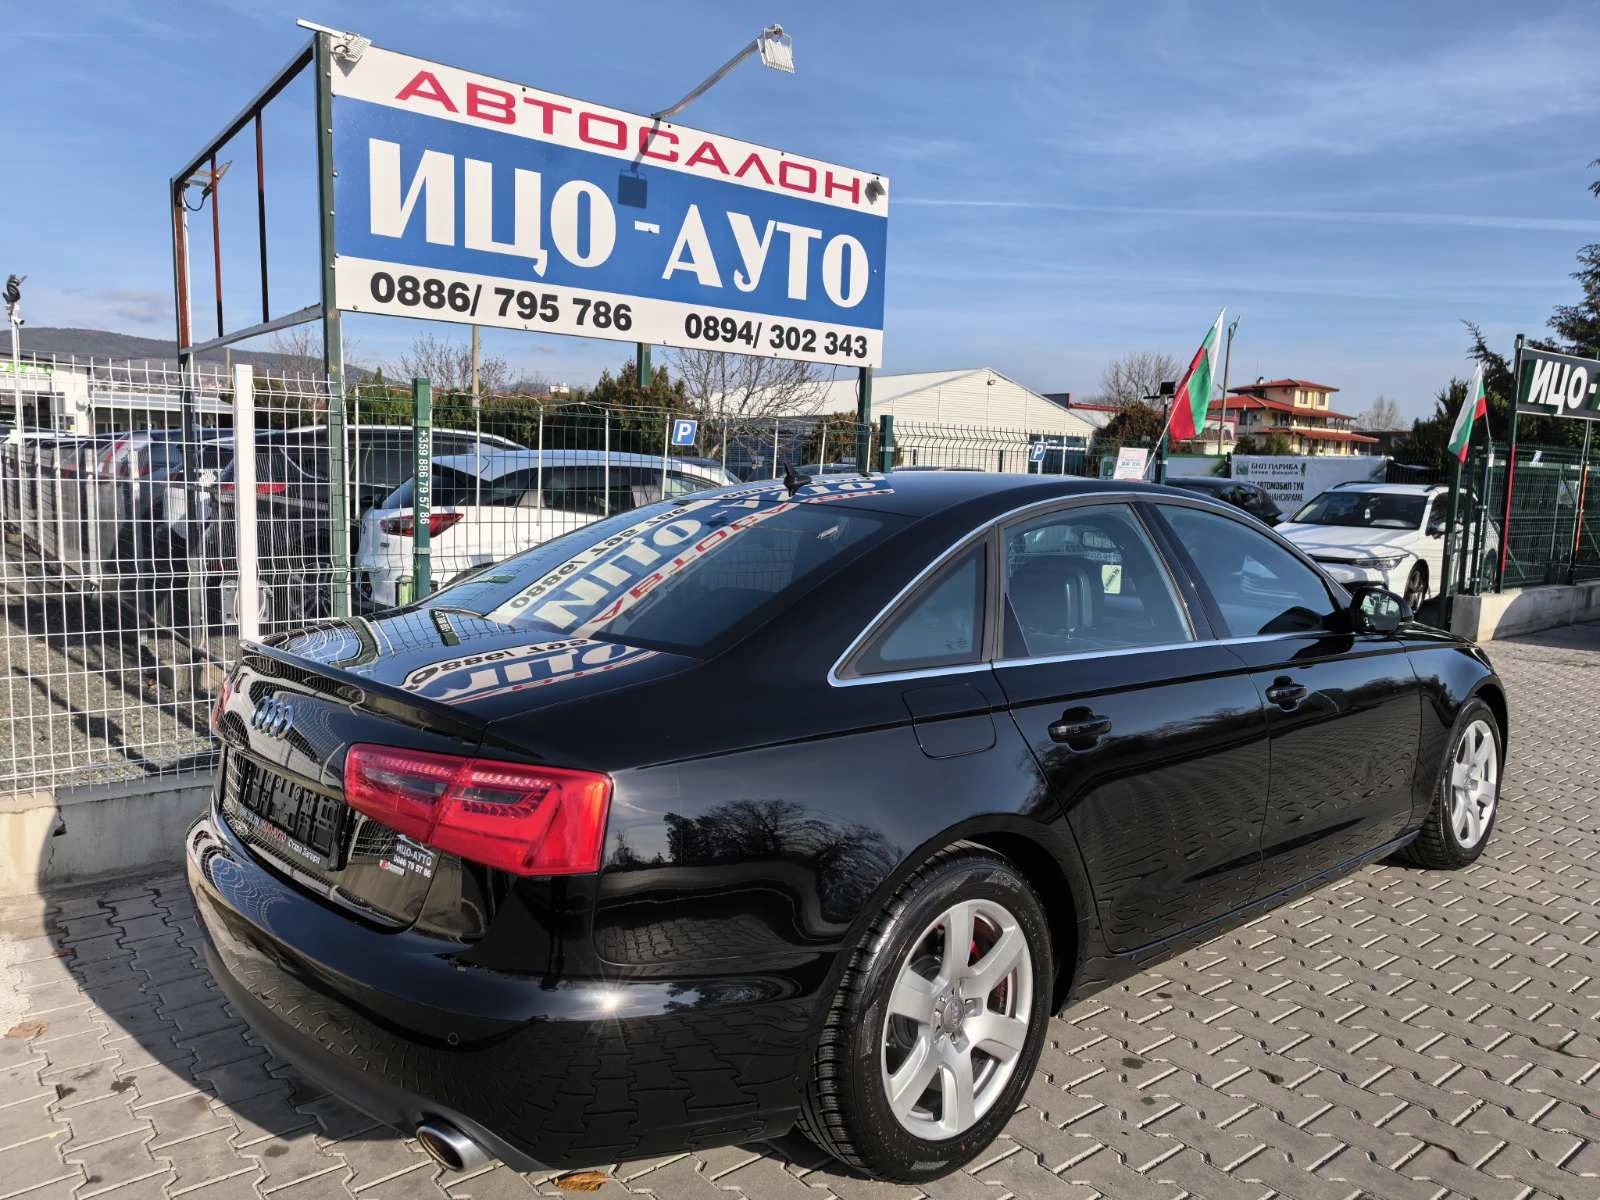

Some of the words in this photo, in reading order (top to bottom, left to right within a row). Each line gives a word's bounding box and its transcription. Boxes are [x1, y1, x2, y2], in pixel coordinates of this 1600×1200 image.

[395, 70, 861, 204] АВТОСАЛОН
[370, 271, 482, 317] 0886/
[494, 286, 560, 323] 795
[572, 297, 633, 331] 786
[684, 312, 762, 348] 0894/
[769, 324, 817, 353] 302
[824, 331, 868, 359] 343
[1527, 358, 1600, 415] ИЦО-
[677, 423, 692, 442] P
[418, 430, 429, 456] +359
[1033, 445, 1044, 460] P
[418, 459, 429, 478] 886
[418, 480, 429, 494] 79
[419, 496, 430, 510] 57
[420, 511, 431, 525] 86
